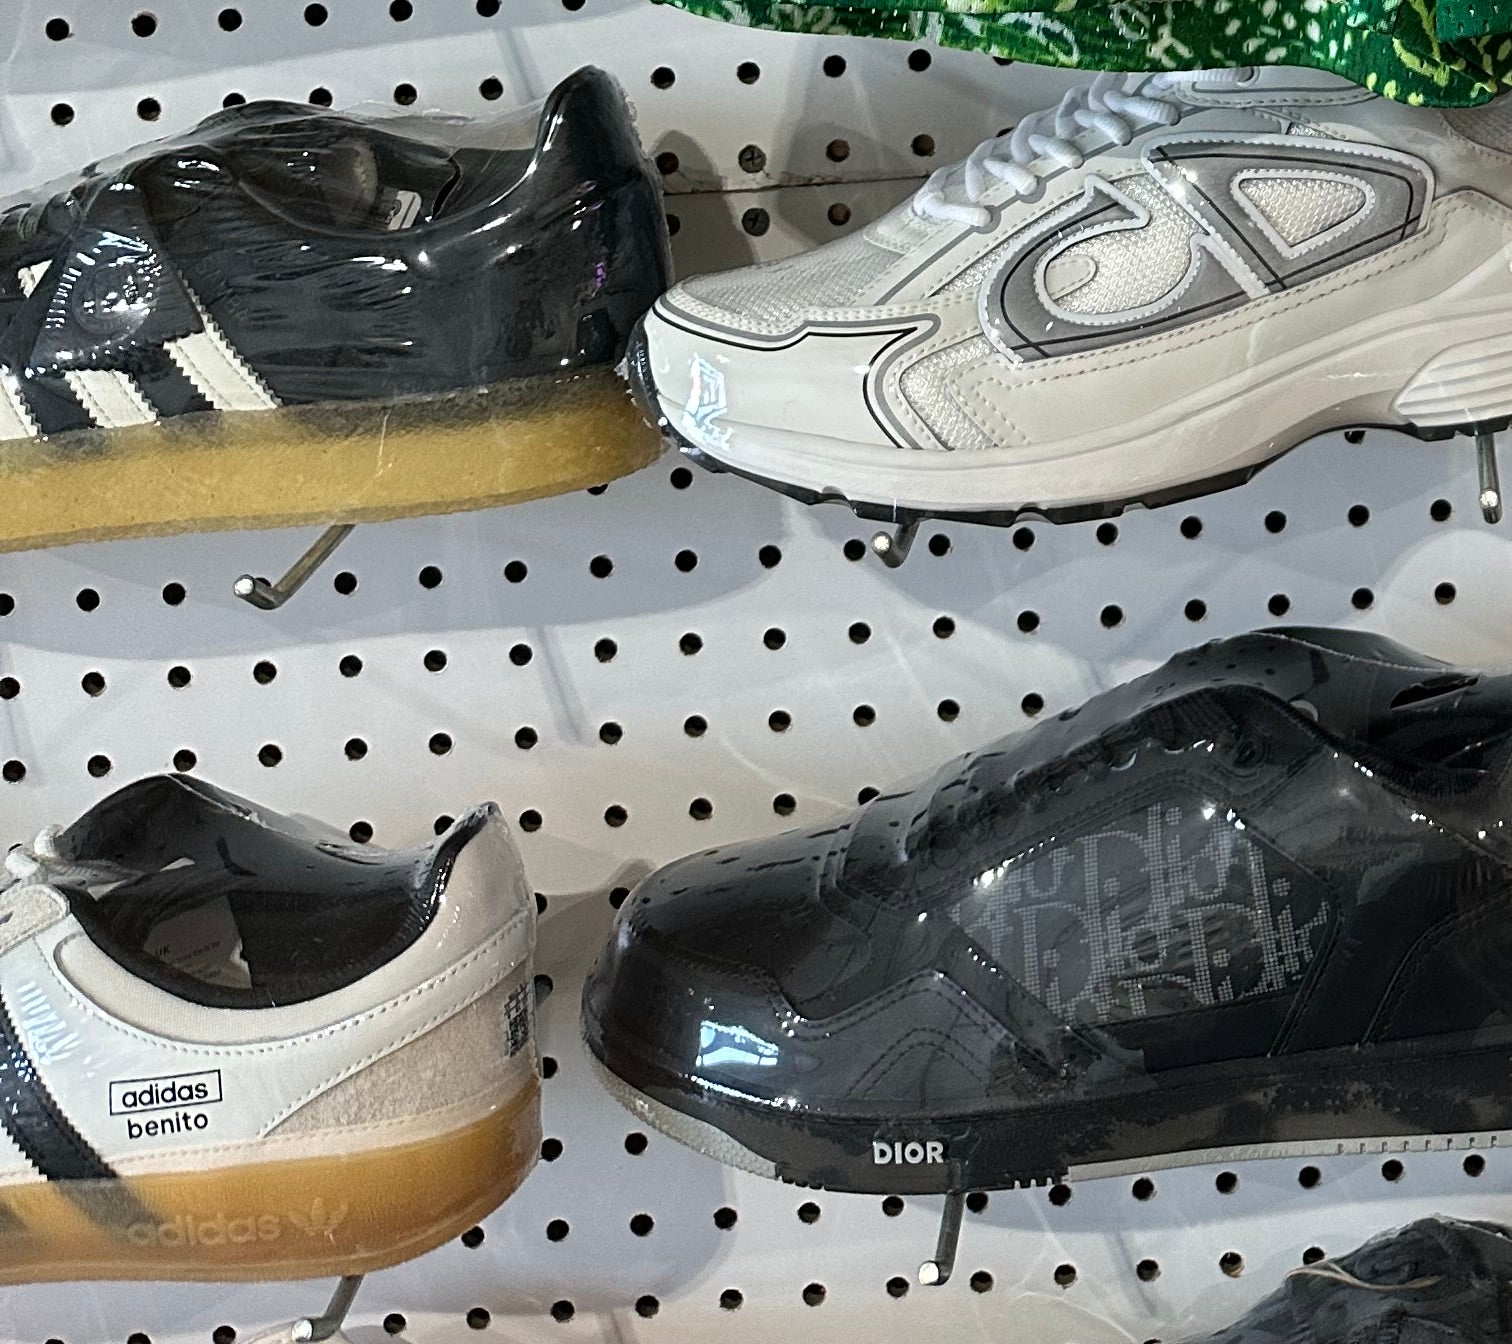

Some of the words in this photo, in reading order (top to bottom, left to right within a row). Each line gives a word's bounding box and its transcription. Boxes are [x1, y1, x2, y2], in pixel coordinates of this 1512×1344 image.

[122, 1080, 209, 1109] adidas
[127, 1111, 208, 1140] benito
[873, 1141, 944, 1165] DIOR
[127, 1212, 281, 1248] adidas
